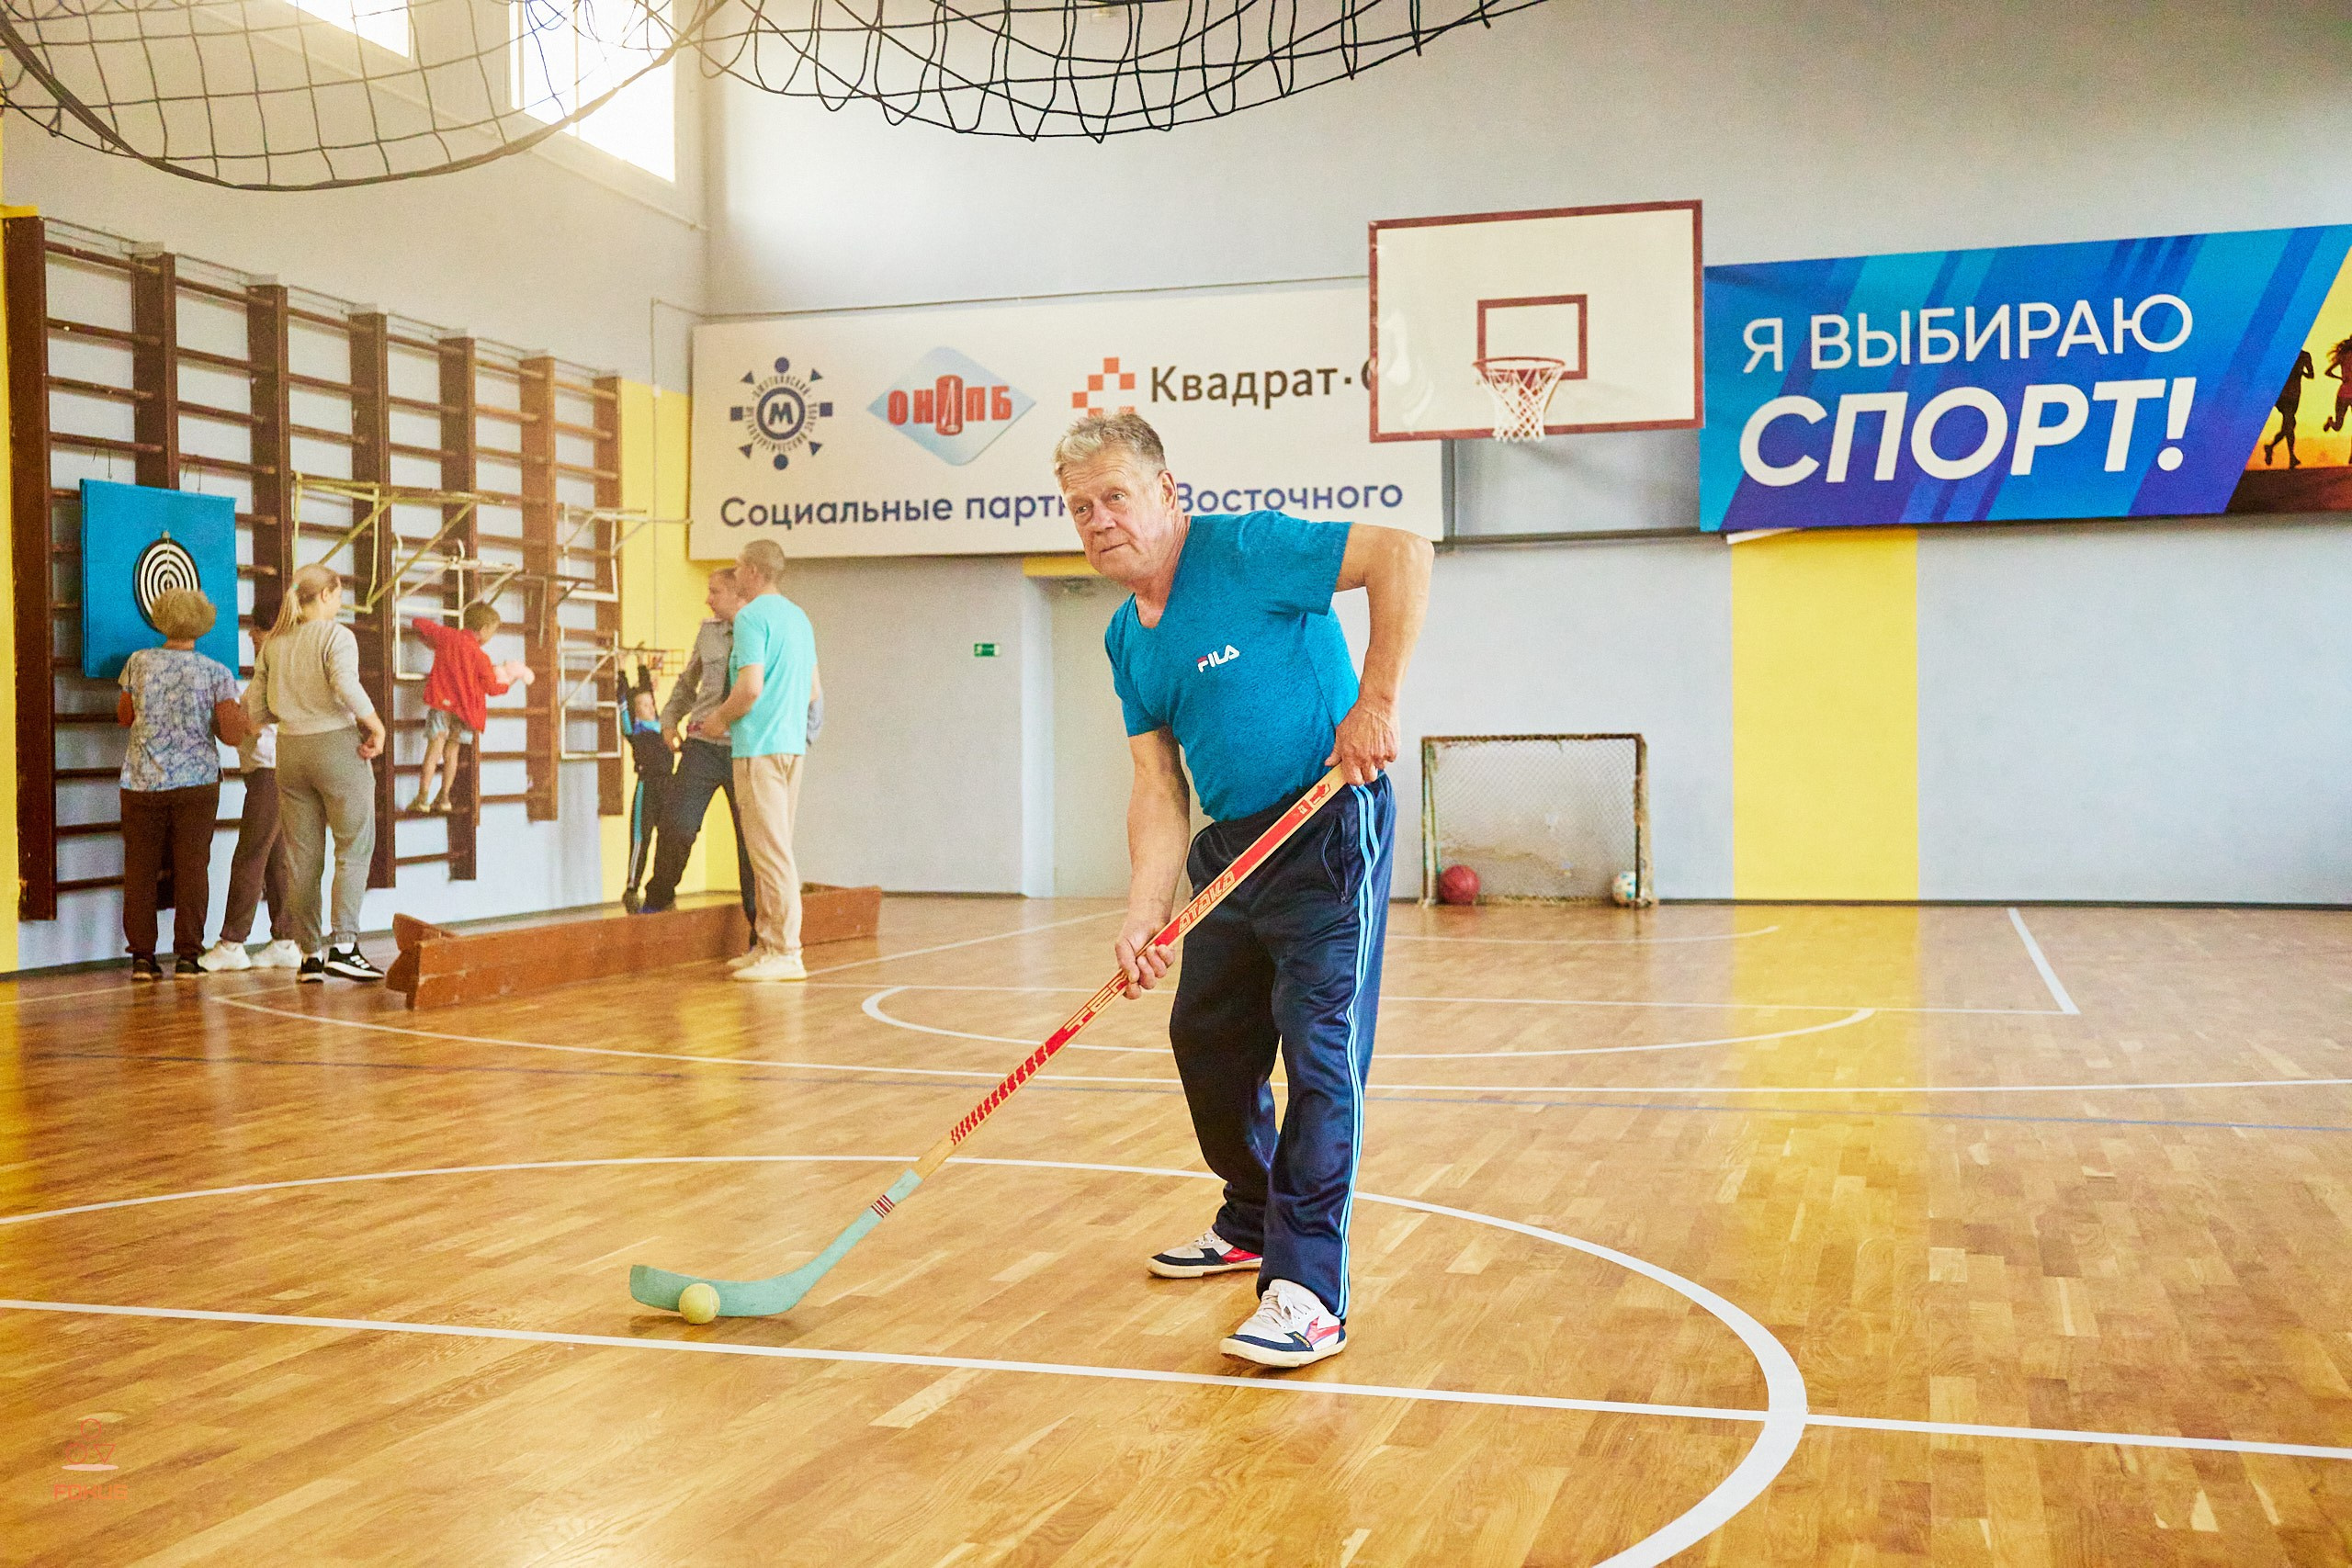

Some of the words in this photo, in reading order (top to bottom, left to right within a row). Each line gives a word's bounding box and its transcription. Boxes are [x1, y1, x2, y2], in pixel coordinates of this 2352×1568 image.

[1742, 318, 1785, 373] Я
[1810, 294, 2194, 370] ВЫБИРАЮ
[1738, 377, 2198, 488] СПОРТ!
[720, 496, 954, 530] Социальные
[1177, 482, 1403, 513] Восточного
[1196, 644, 1240, 673] FILA
